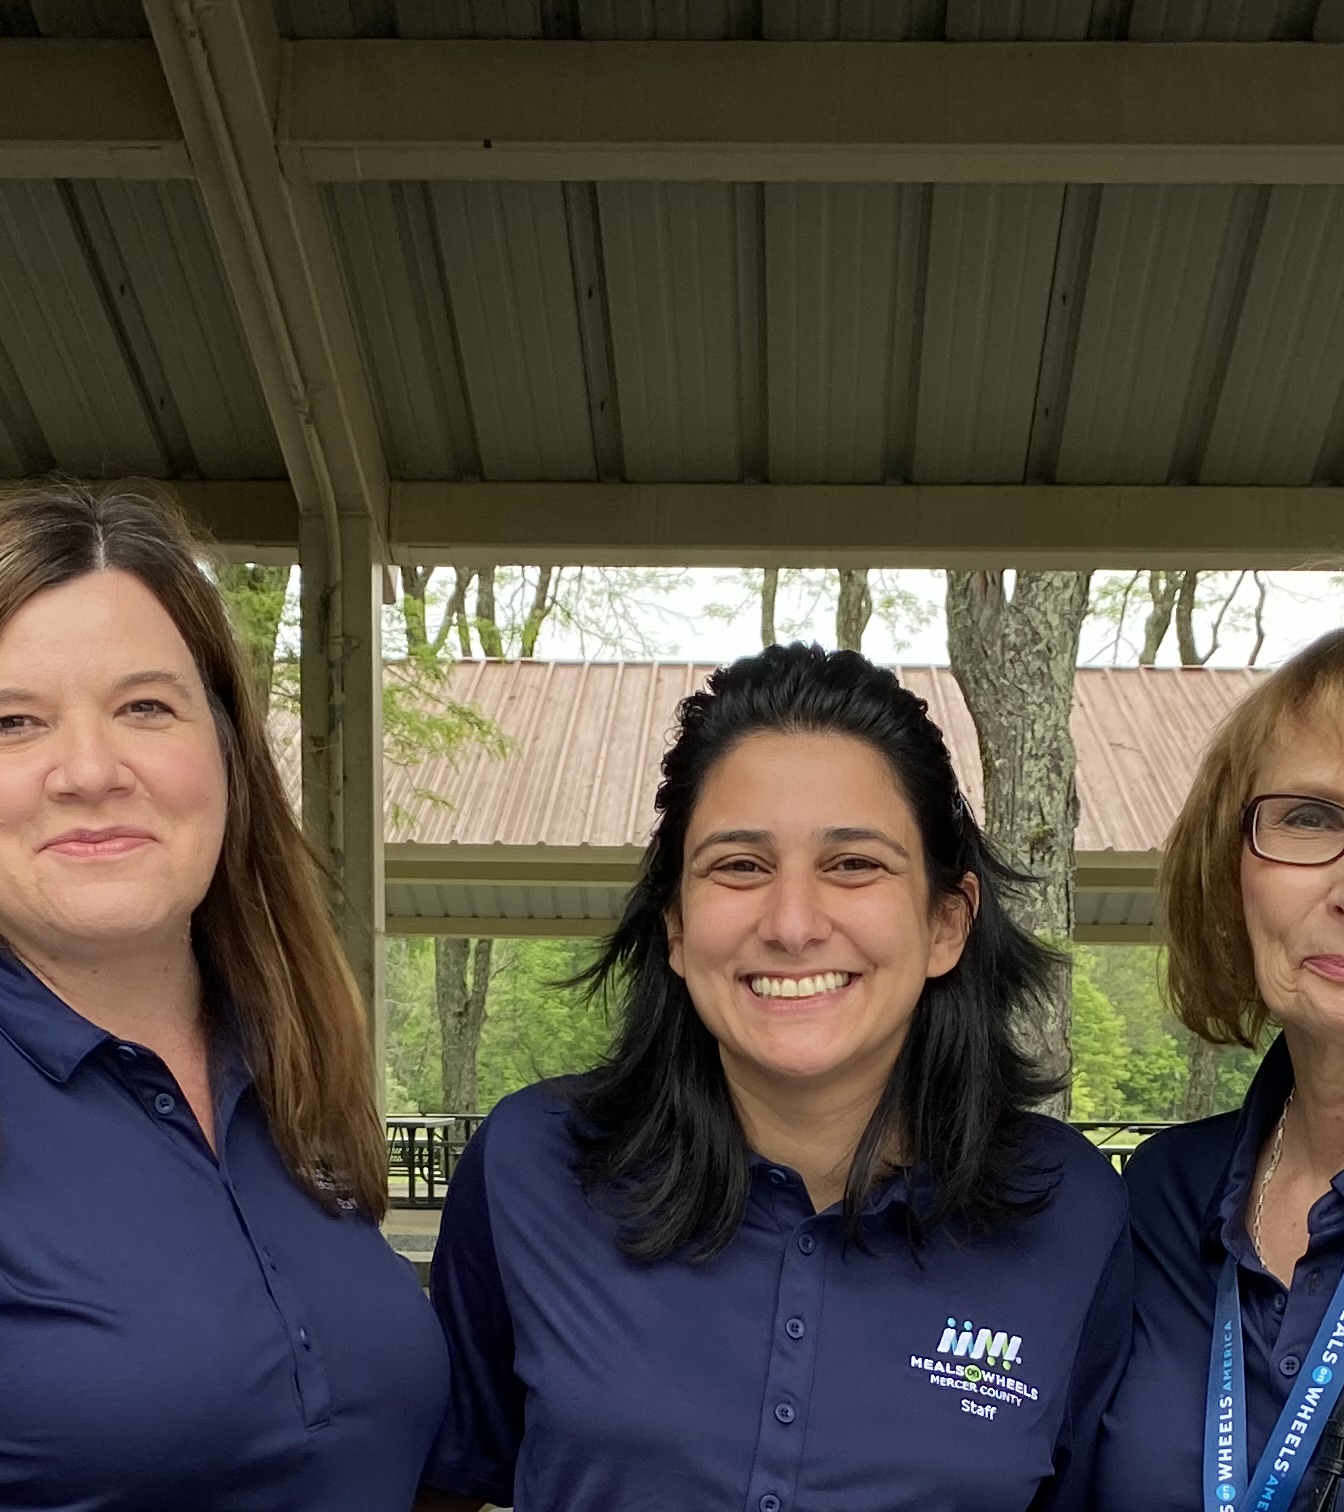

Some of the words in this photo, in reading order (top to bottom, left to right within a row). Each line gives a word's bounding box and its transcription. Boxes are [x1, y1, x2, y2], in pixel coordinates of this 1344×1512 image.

[910, 1355, 966, 1377] MEALS
[981, 1370, 1039, 1401] WHEELS
[1222, 1319, 1233, 1392] AMERICA
[1314, 1368, 1330, 1383] on
[929, 1373, 979, 1393] MERCER
[979, 1385, 1024, 1408] COUNTY
[960, 1399, 998, 1421] Staff
[1217, 1394, 1234, 1482] WHEELS
[1273, 1386, 1325, 1474] WHEELS
